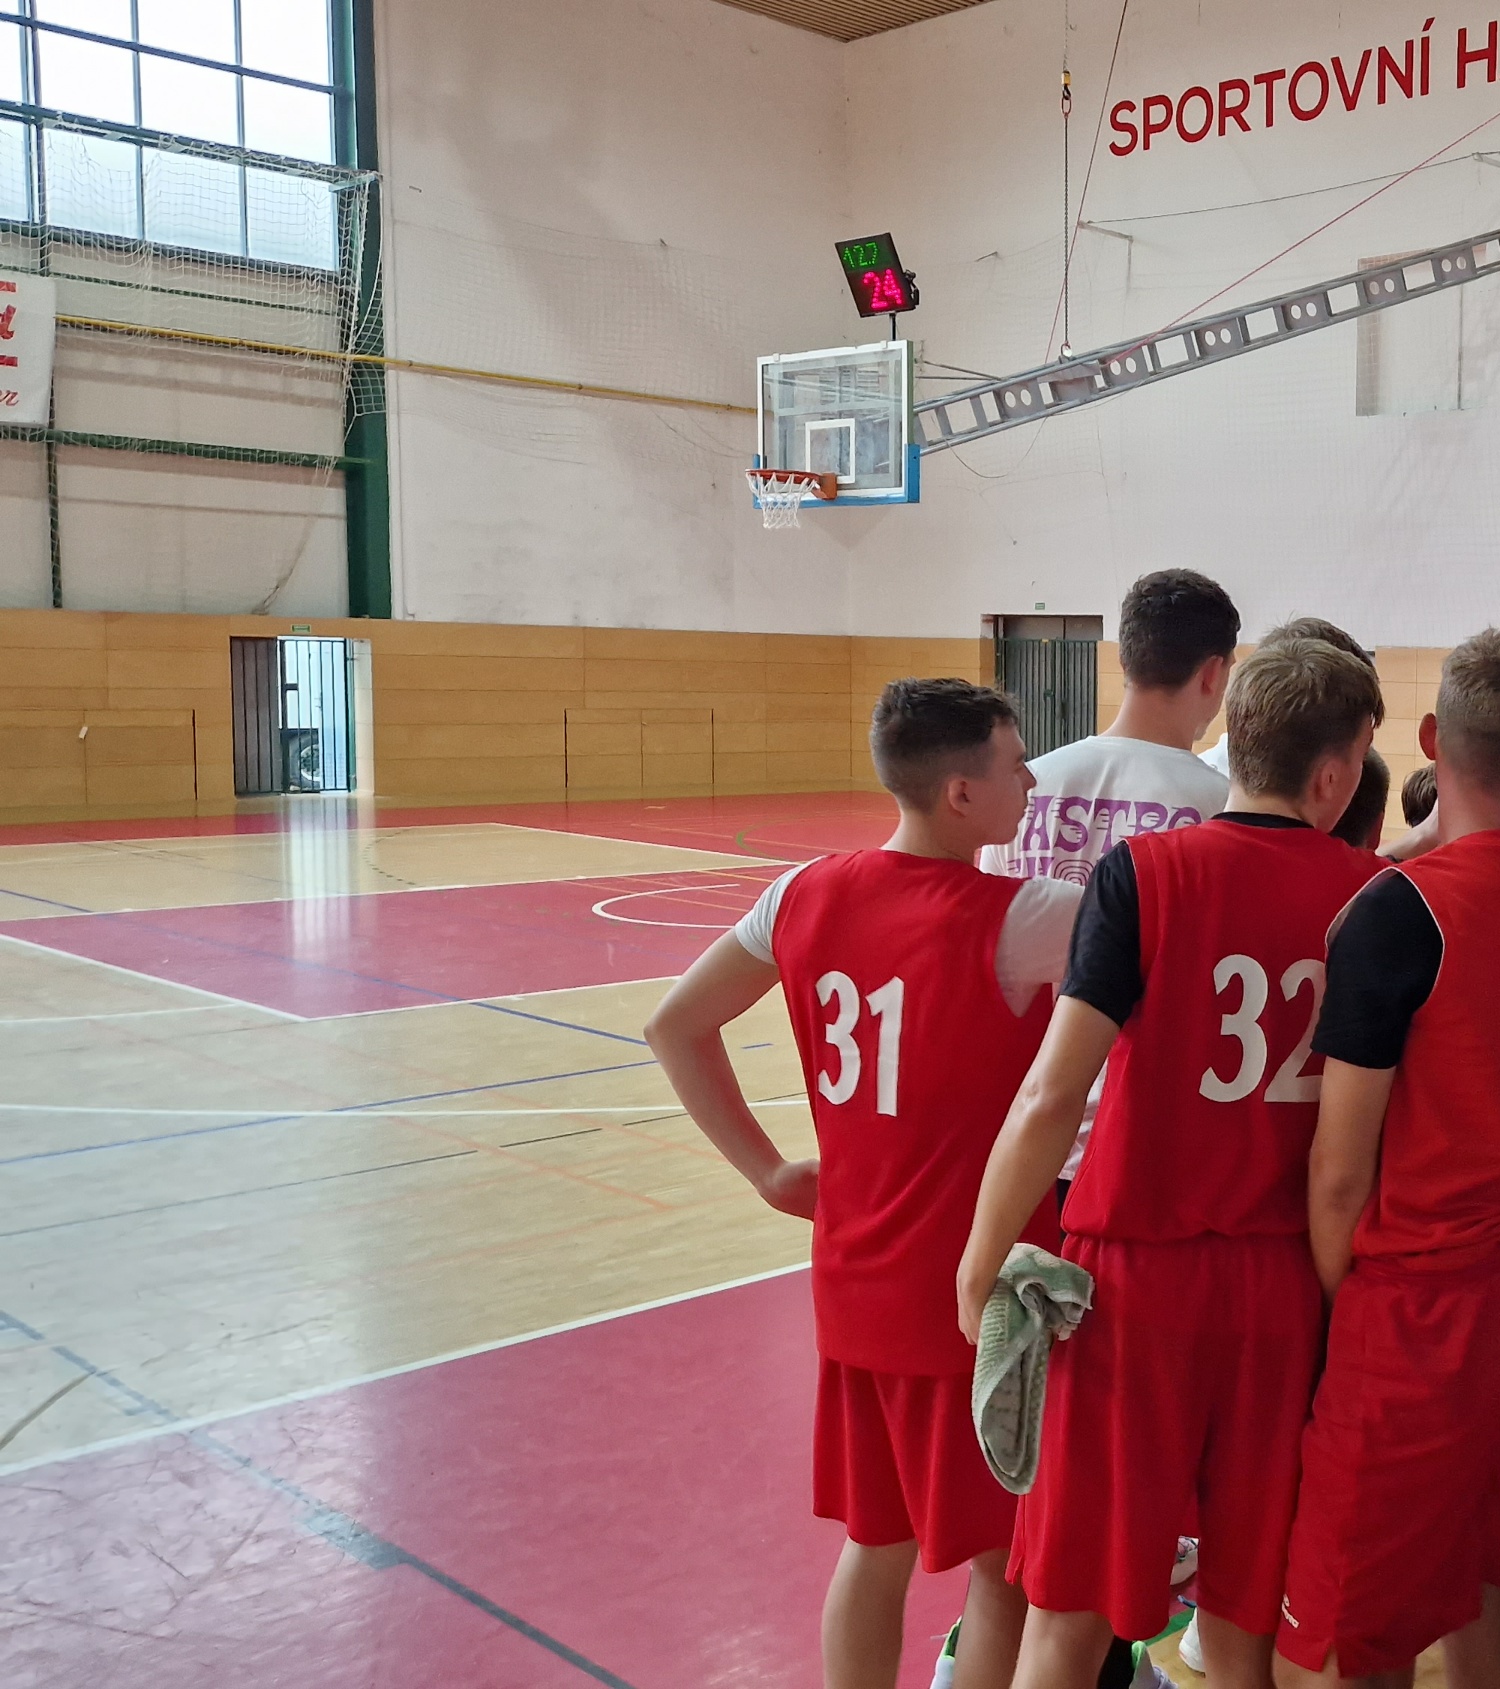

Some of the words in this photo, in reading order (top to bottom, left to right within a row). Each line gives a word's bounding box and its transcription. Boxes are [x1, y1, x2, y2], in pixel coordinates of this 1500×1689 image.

[1109, 17, 1435, 156] SPORTOVNÍ
[863, 269, 902, 309] 24
[815, 970, 904, 1117] 31
[1199, 954, 1327, 1103] 32
